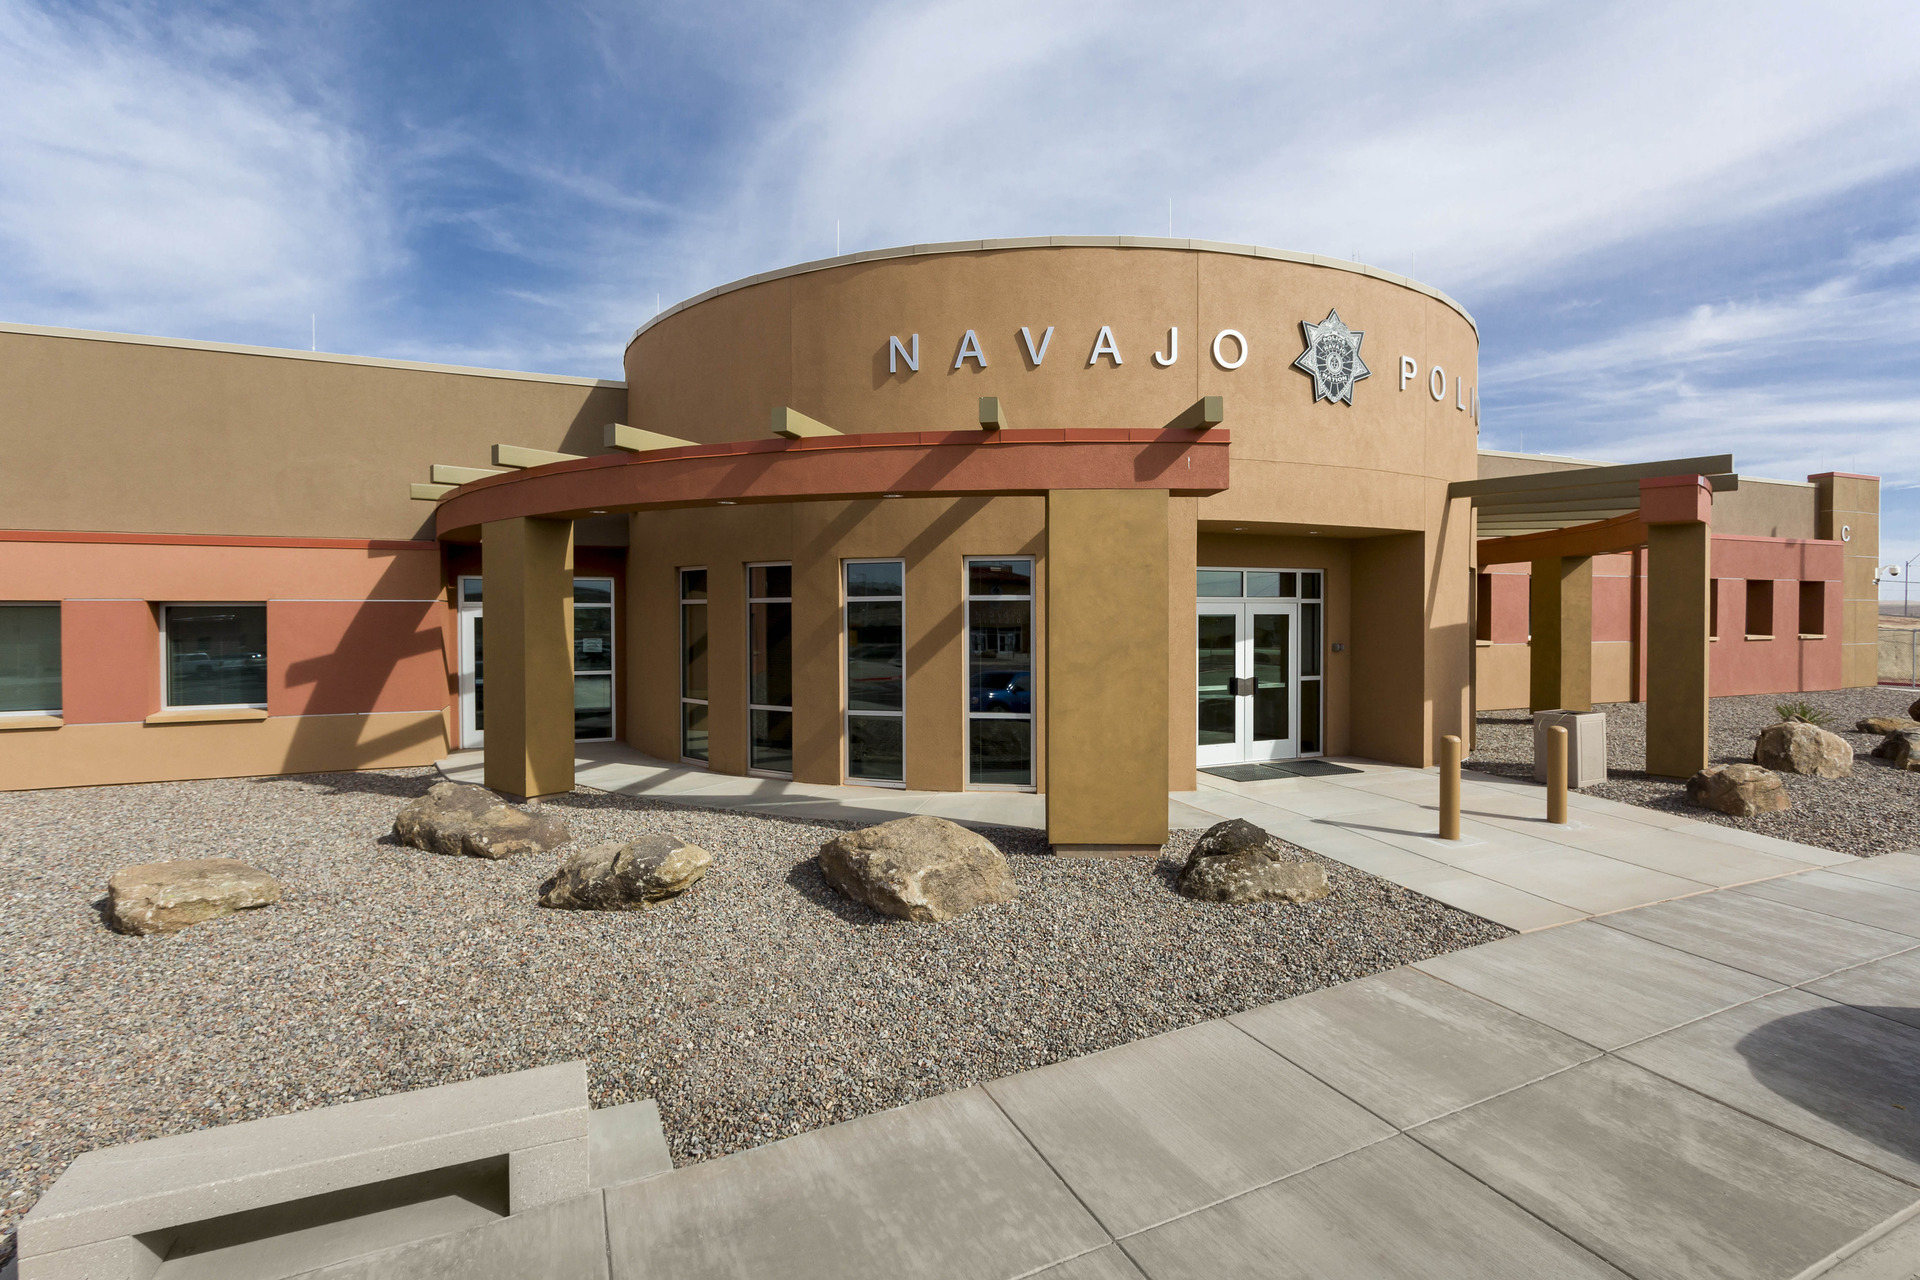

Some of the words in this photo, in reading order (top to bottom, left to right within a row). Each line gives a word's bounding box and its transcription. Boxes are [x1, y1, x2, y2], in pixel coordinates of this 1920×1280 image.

[889, 325, 1249, 374] NAVAJO
[1322, 372, 1348, 382] NATION
[1841, 525, 1850, 542] C
